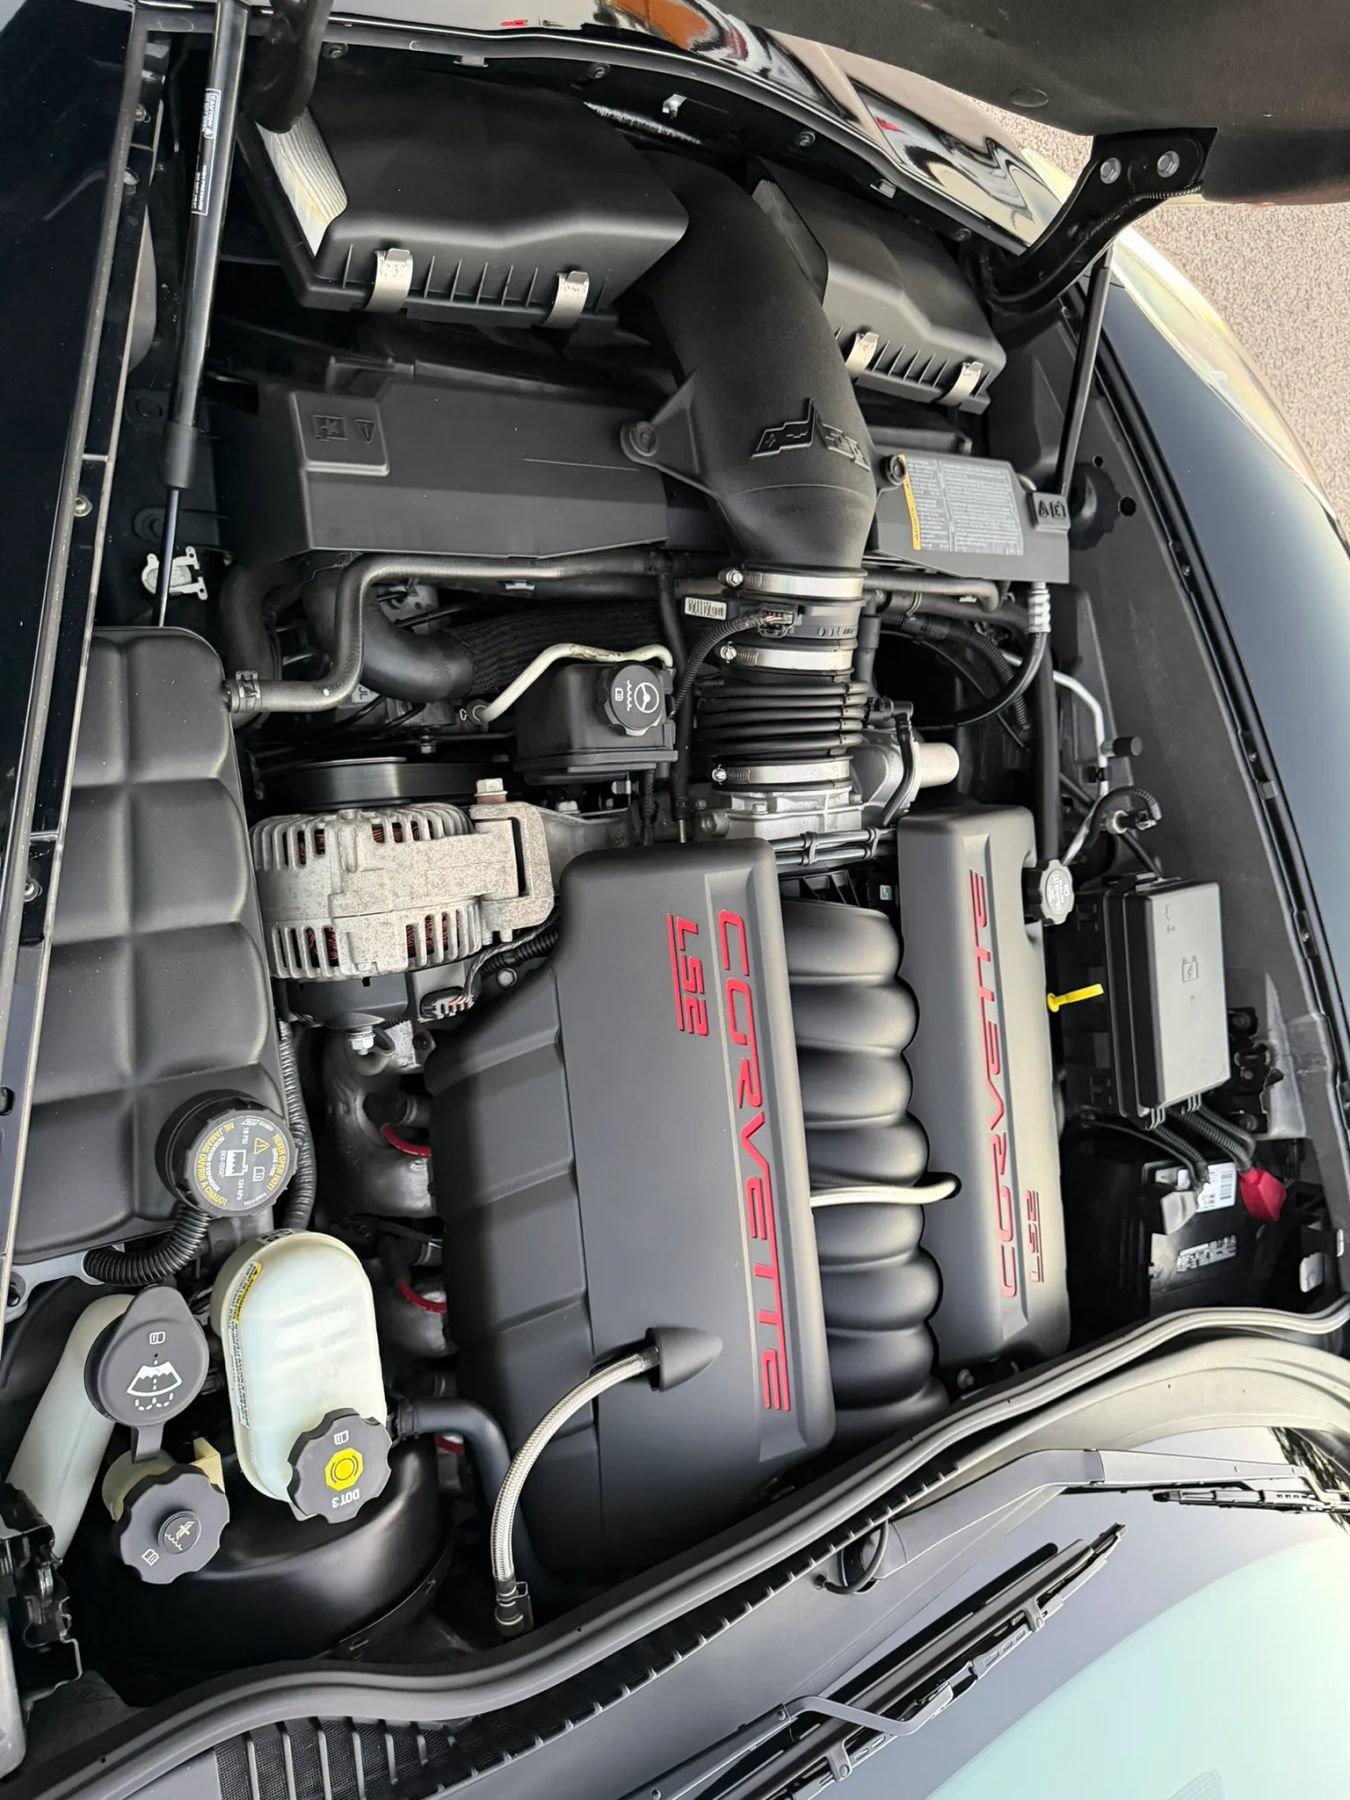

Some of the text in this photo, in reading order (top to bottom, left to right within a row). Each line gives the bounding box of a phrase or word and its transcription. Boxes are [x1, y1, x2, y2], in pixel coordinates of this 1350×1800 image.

[207, 95, 216, 127] CAUTION
[674, 914, 709, 1038] LS2
[970, 870, 1016, 1298] CORVETTE
[202, 1129, 223, 1153] JAMAIS
[273, 1135, 286, 1155] NEVER
[197, 1153, 207, 1182] OUVRIR
[275, 1156, 286, 1176] OPEN
[717, 910, 791, 1412] CORVETTE
[1024, 1190, 1042, 1284] LS2
[331, 1487, 361, 1510] DOT 3
